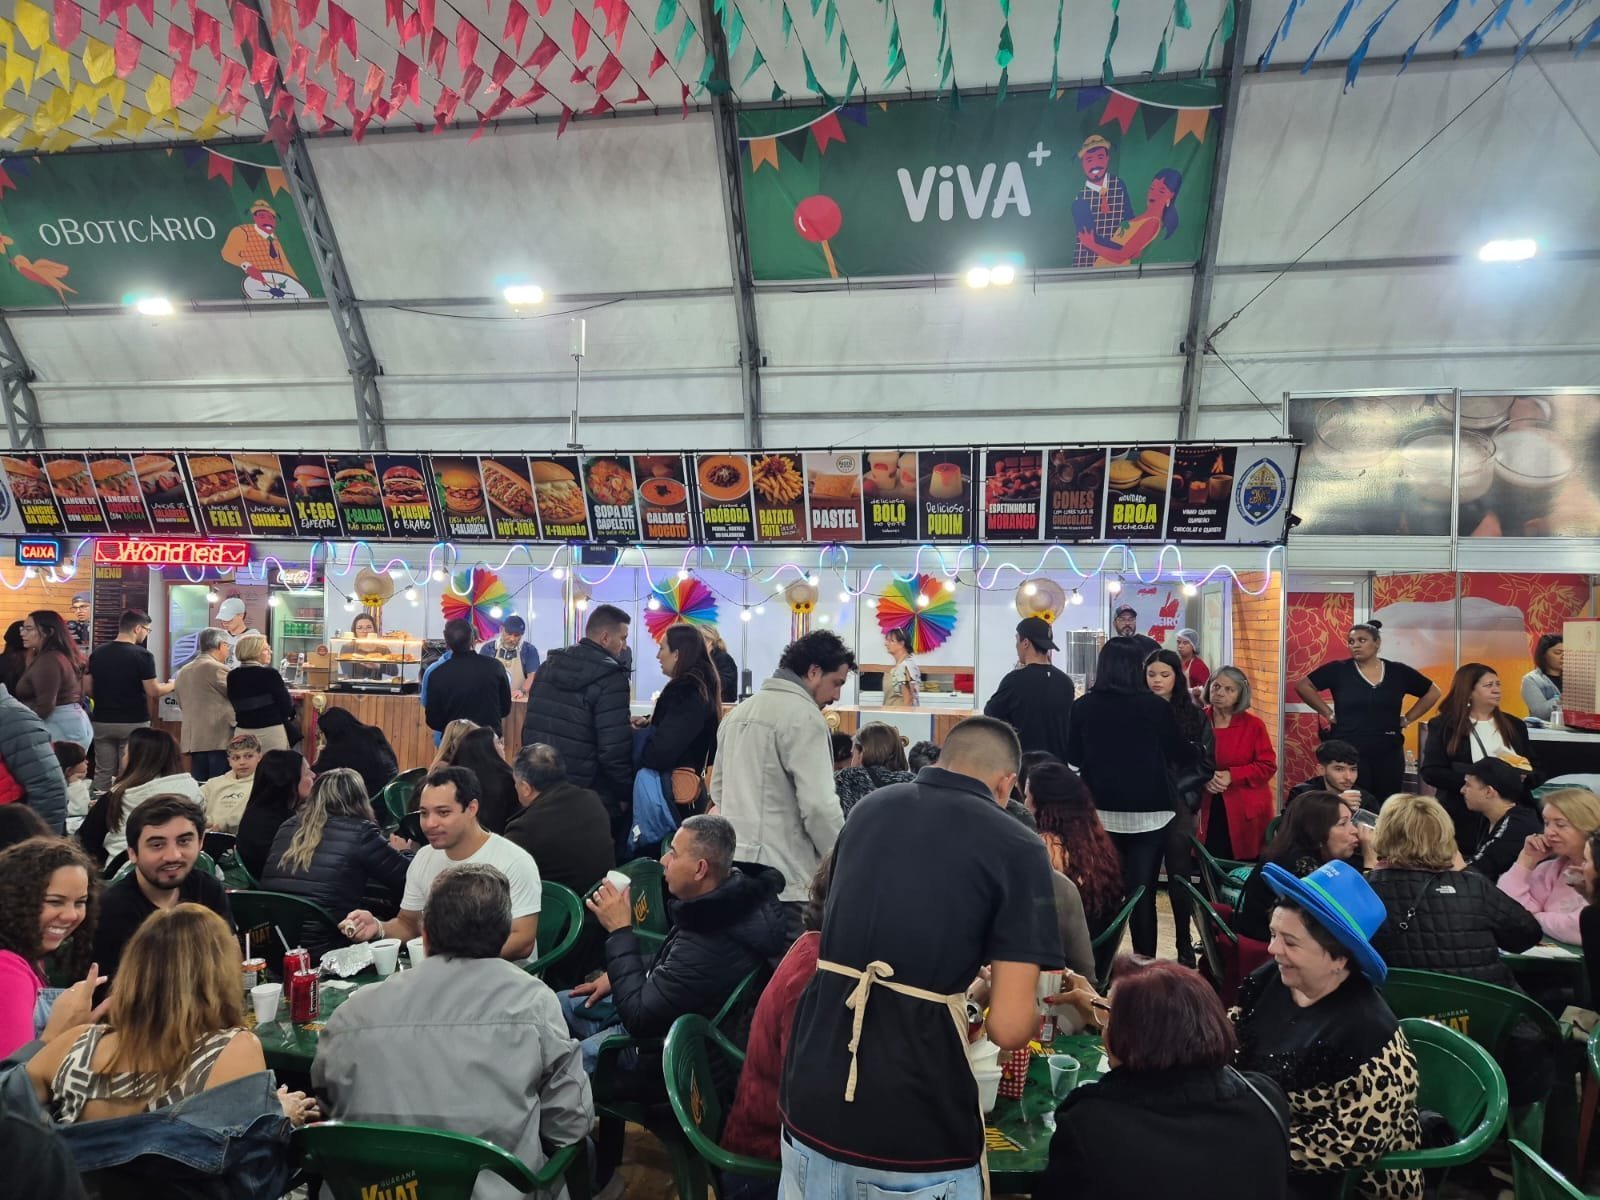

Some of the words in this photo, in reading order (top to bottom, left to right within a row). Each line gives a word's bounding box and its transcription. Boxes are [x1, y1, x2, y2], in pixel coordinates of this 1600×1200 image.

[22, 505, 56, 515] LANCHE
[296, 502, 336, 520] X-EGG
[344, 508, 384, 522] X-SALADA
[390, 505, 431, 519] X-BACON
[594, 505, 621, 518] SOPA
[621, 505, 635, 518] DE
[705, 506, 750, 523] ABÓBORA
[873, 504, 906, 522] BOLO
[926, 502, 965, 514] Delicioso
[990, 503, 1026, 513] ESPETINHOS
[1028, 503, 1036, 513] DE
[1113, 504, 1157, 523] BROA
[209, 511, 243, 527] FREI
[250, 513, 292, 527] SHIMEJI
[647, 512, 674, 523] CALDO
[674, 512, 686, 523] DE
[759, 509, 795, 524] BATATA
[812, 509, 858, 529] PASTEL
[988, 514, 1036, 529] MORANGO
[301, 519, 336, 529] ESPECIAL
[497, 521, 535, 535] HOT-DOG
[545, 523, 587, 536] X-FRANGÃO
[596, 518, 636, 530] CAPELETTI
[761, 525, 781, 536] FRITA
[928, 514, 962, 535] PUDIM
[22, 546, 56, 560] CAIXA
[96, 567, 122, 578] MENU
